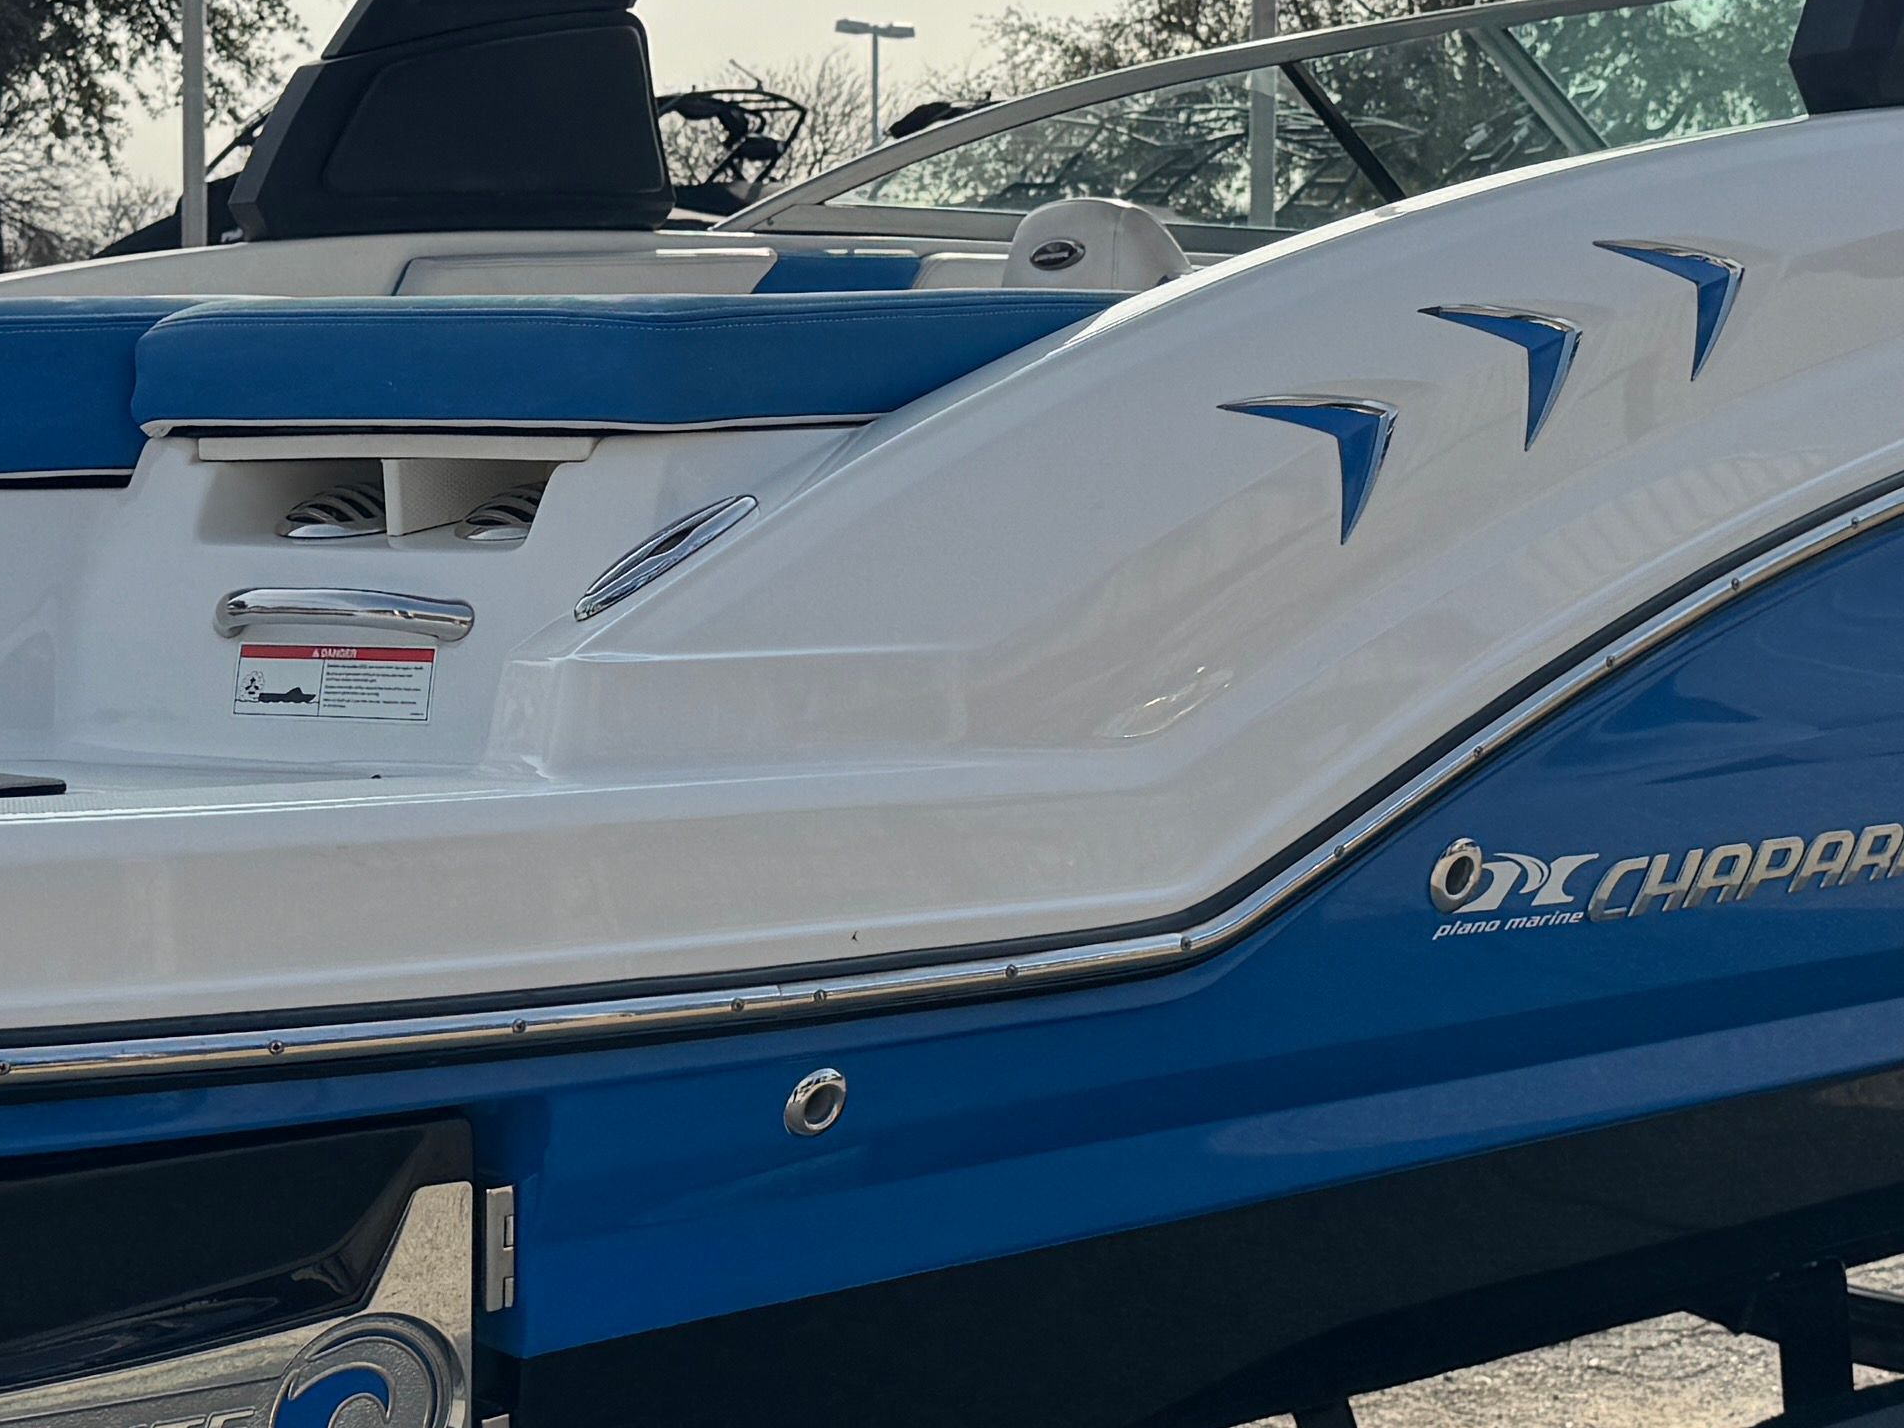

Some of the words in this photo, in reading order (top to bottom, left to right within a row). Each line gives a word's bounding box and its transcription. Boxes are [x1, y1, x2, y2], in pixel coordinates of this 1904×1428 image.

[321, 648, 357, 659] DANGER
[1432, 920, 1501, 941] plano
[1504, 911, 1584, 931] marine
